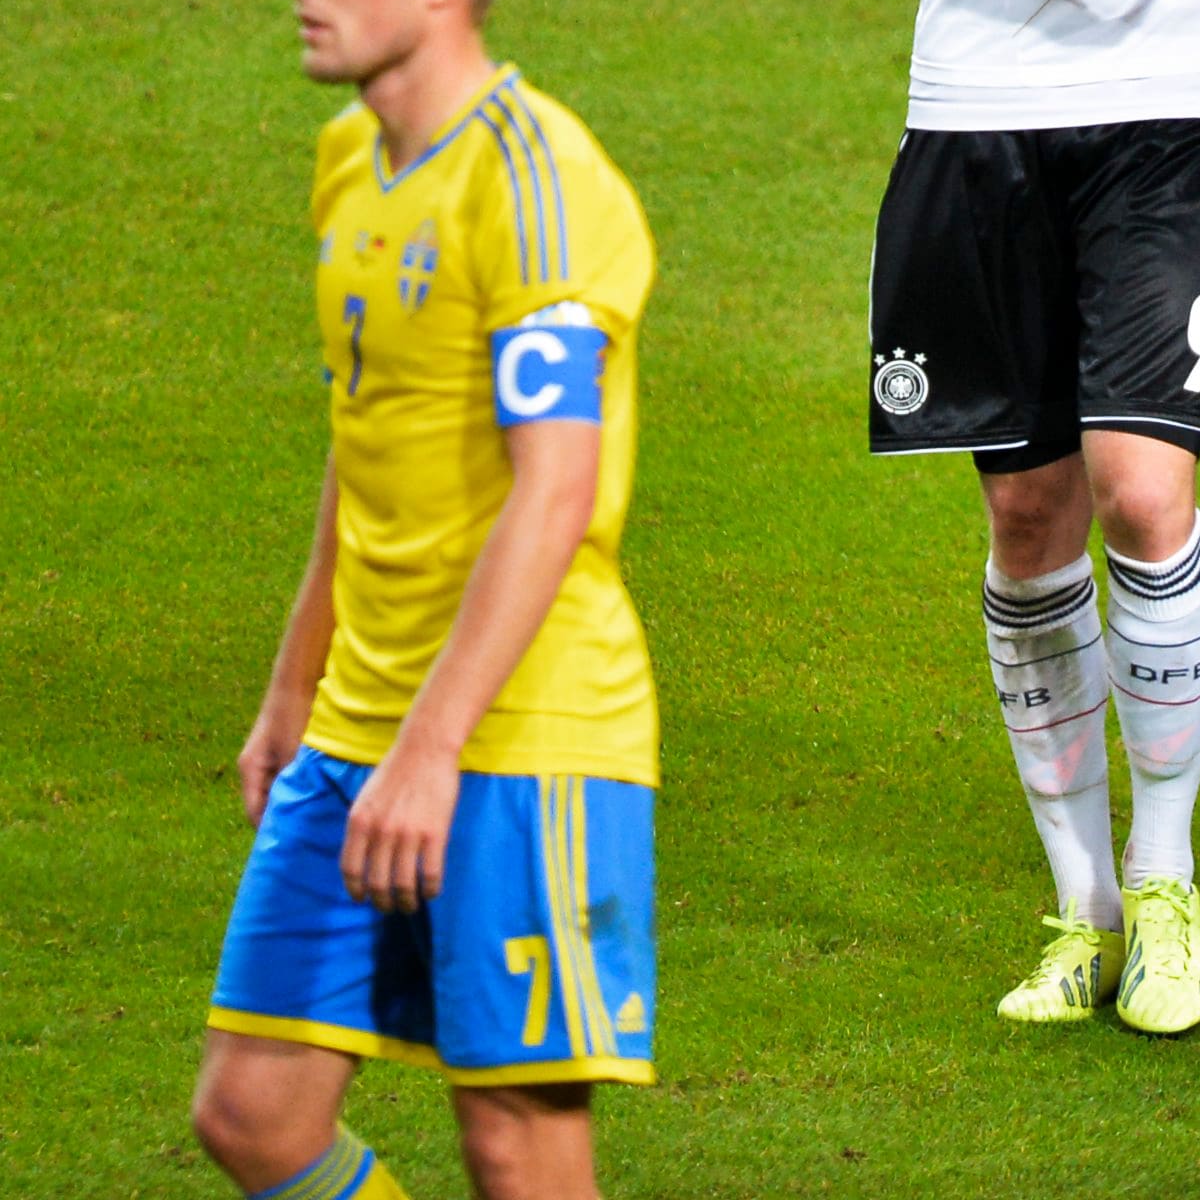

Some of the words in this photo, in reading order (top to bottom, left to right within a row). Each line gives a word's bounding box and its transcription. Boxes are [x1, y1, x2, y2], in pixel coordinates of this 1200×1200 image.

[343, 293, 366, 396] 7
[497, 329, 567, 416] C
[999, 686, 1051, 708] FB
[504, 934, 550, 1046] 7
